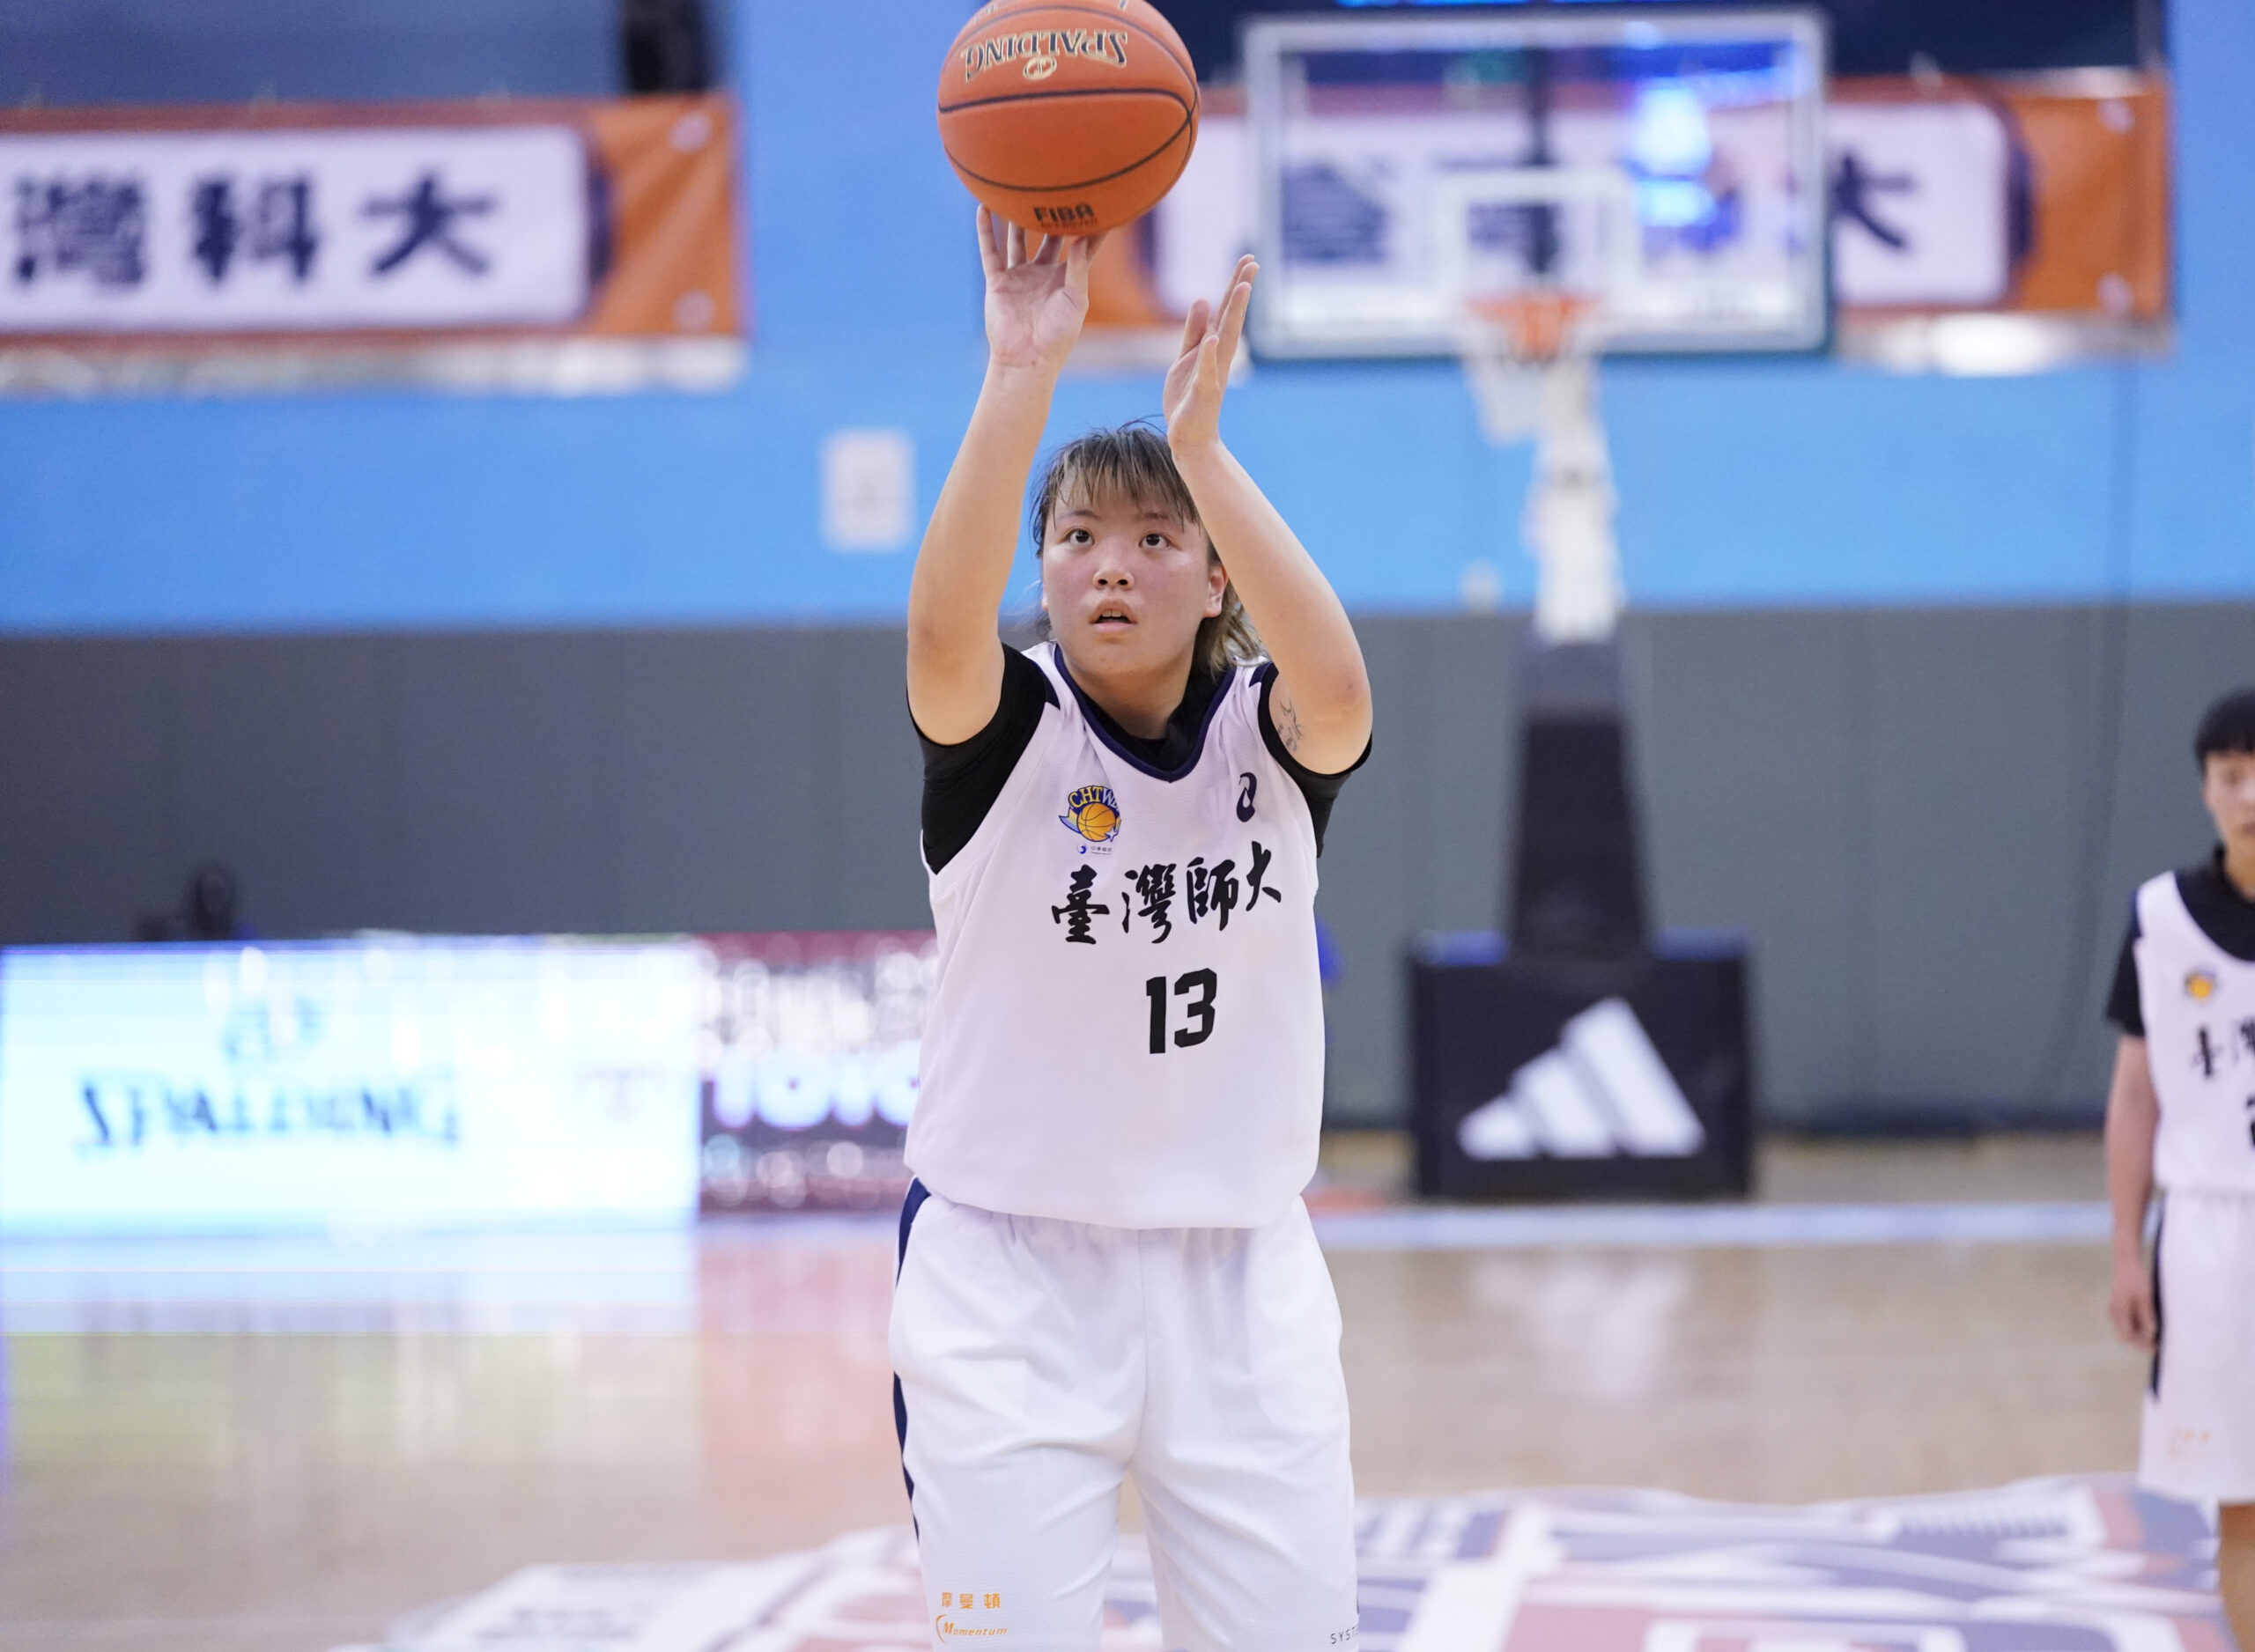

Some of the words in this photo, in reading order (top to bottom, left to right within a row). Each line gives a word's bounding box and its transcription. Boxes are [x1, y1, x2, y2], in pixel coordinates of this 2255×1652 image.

[961, 27, 1128, 83] SPALDING
[1033, 203, 1094, 223] FIBA
[1051, 840, 1283, 946] 臺灣師大
[1146, 967, 1218, 1055] 13
[943, 1621, 1008, 1636] Momentum
